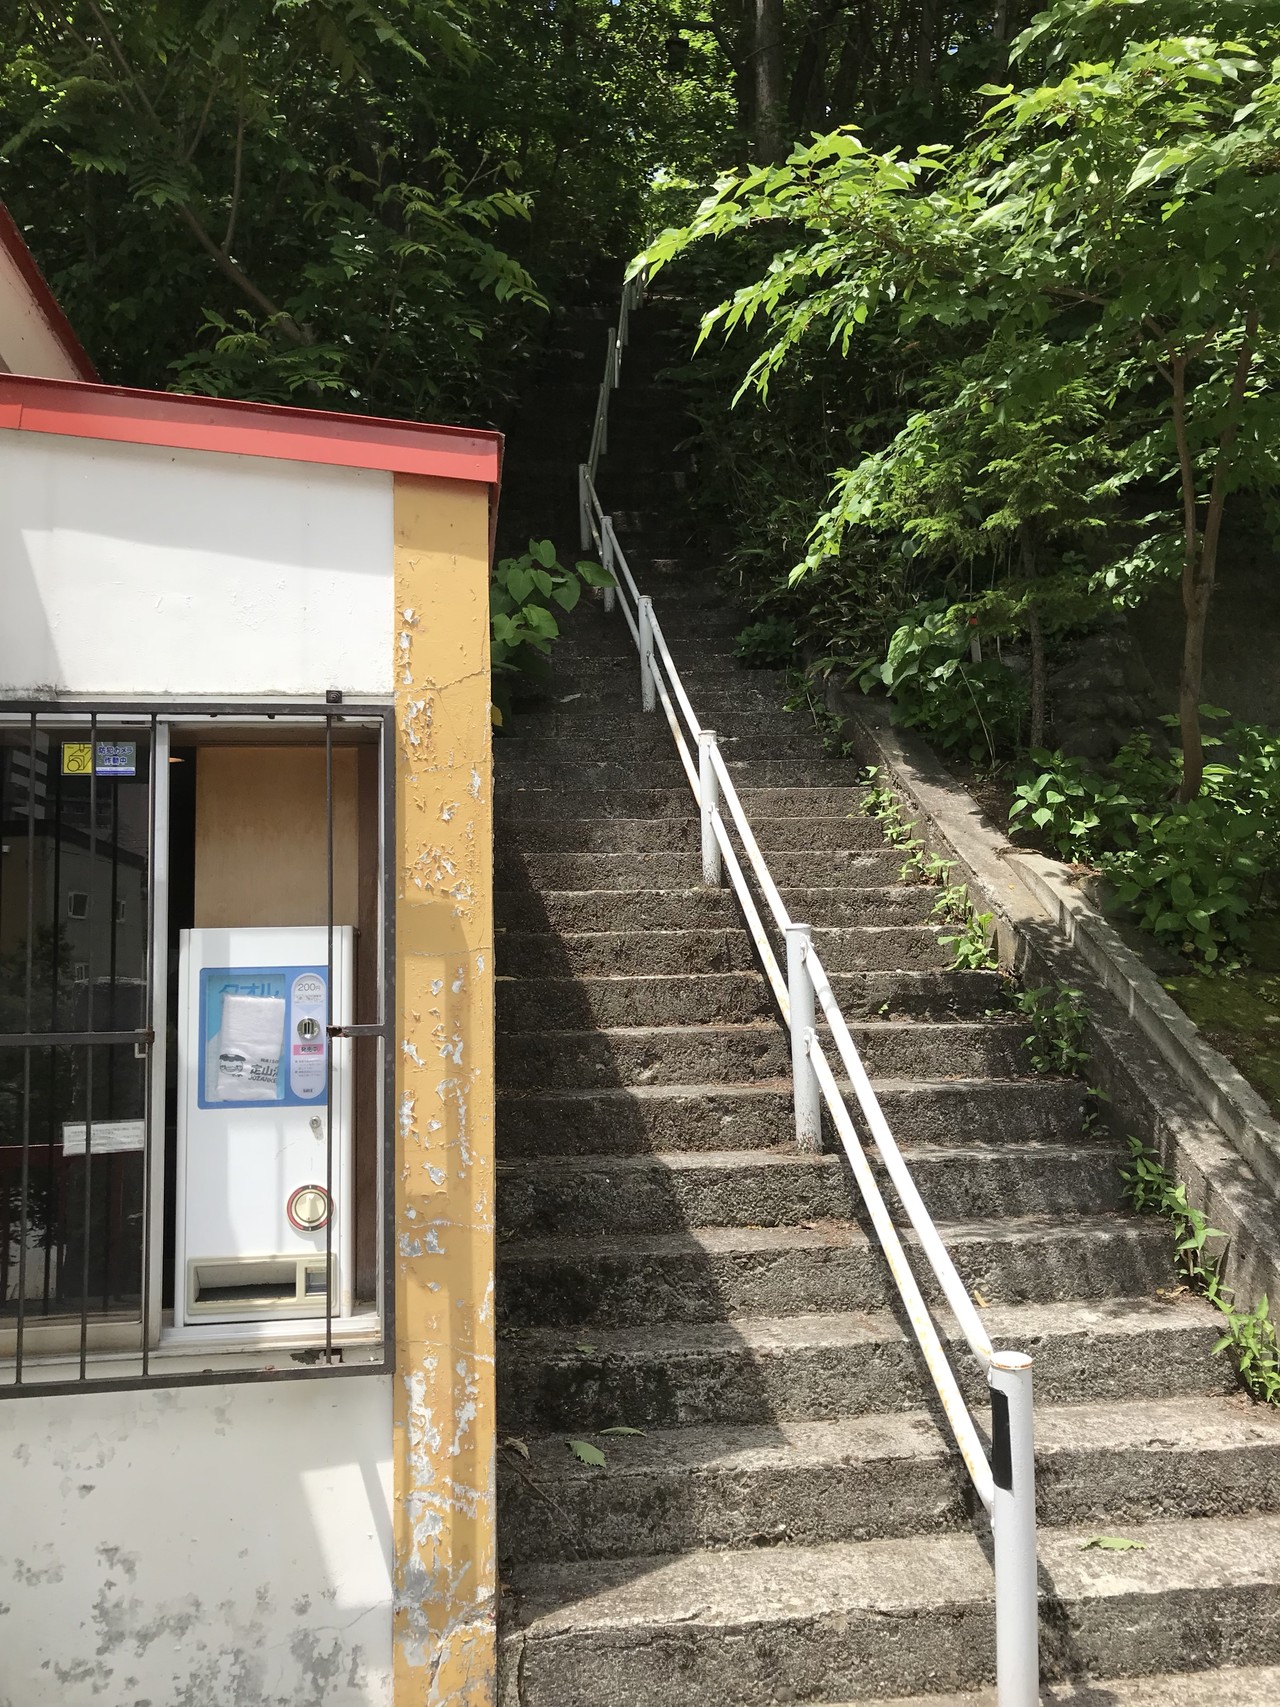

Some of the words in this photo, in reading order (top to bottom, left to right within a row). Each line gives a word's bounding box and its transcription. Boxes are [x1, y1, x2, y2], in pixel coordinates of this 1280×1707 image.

[98, 746, 133, 755] 防犯カメラ
[104, 757, 127, 766] 作動中
